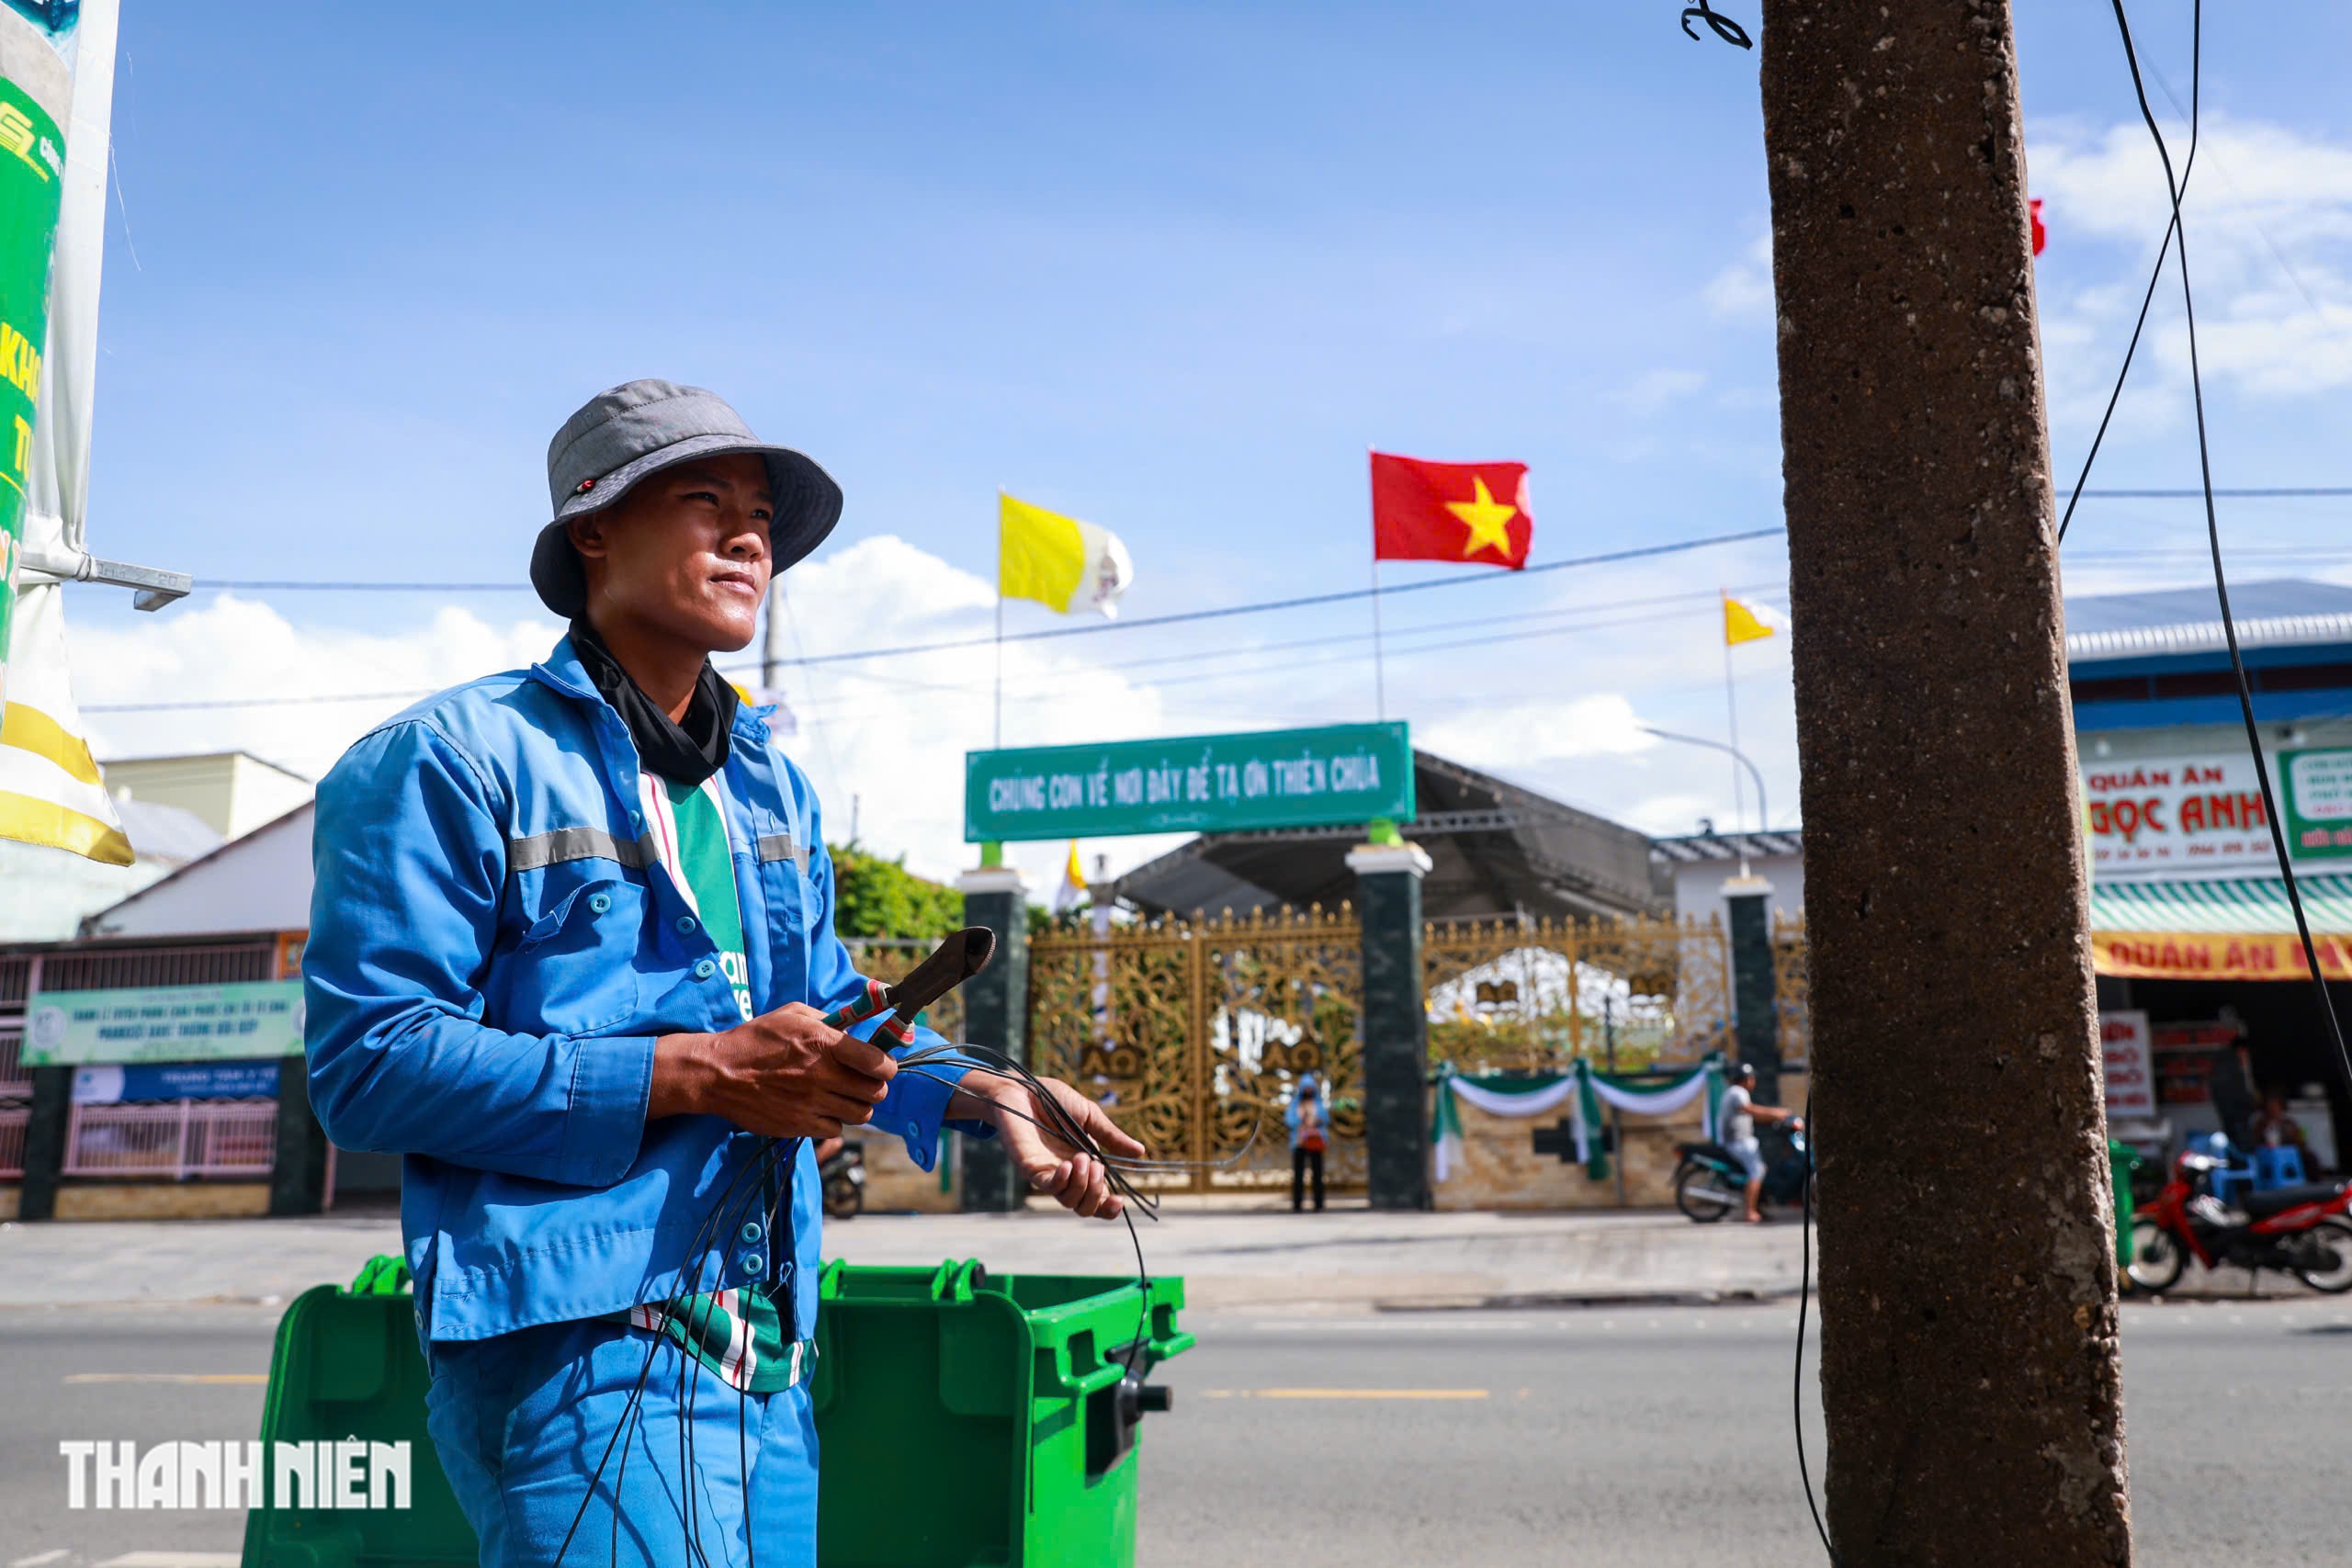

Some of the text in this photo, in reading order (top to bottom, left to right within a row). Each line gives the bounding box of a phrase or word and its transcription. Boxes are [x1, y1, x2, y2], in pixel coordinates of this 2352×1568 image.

[989, 767, 1046, 813] CHÚNG
[1048, 773, 1083, 809] CON
[1216, 763, 1239, 807] TẠ
[1243, 758, 1269, 799] ƠN
[1272, 749, 1327, 796] THIÊN
[1329, 746, 1381, 793] CHÚA
[2088, 767, 2171, 793] QUÁN
[2107, 938, 2211, 970] QUÁN
